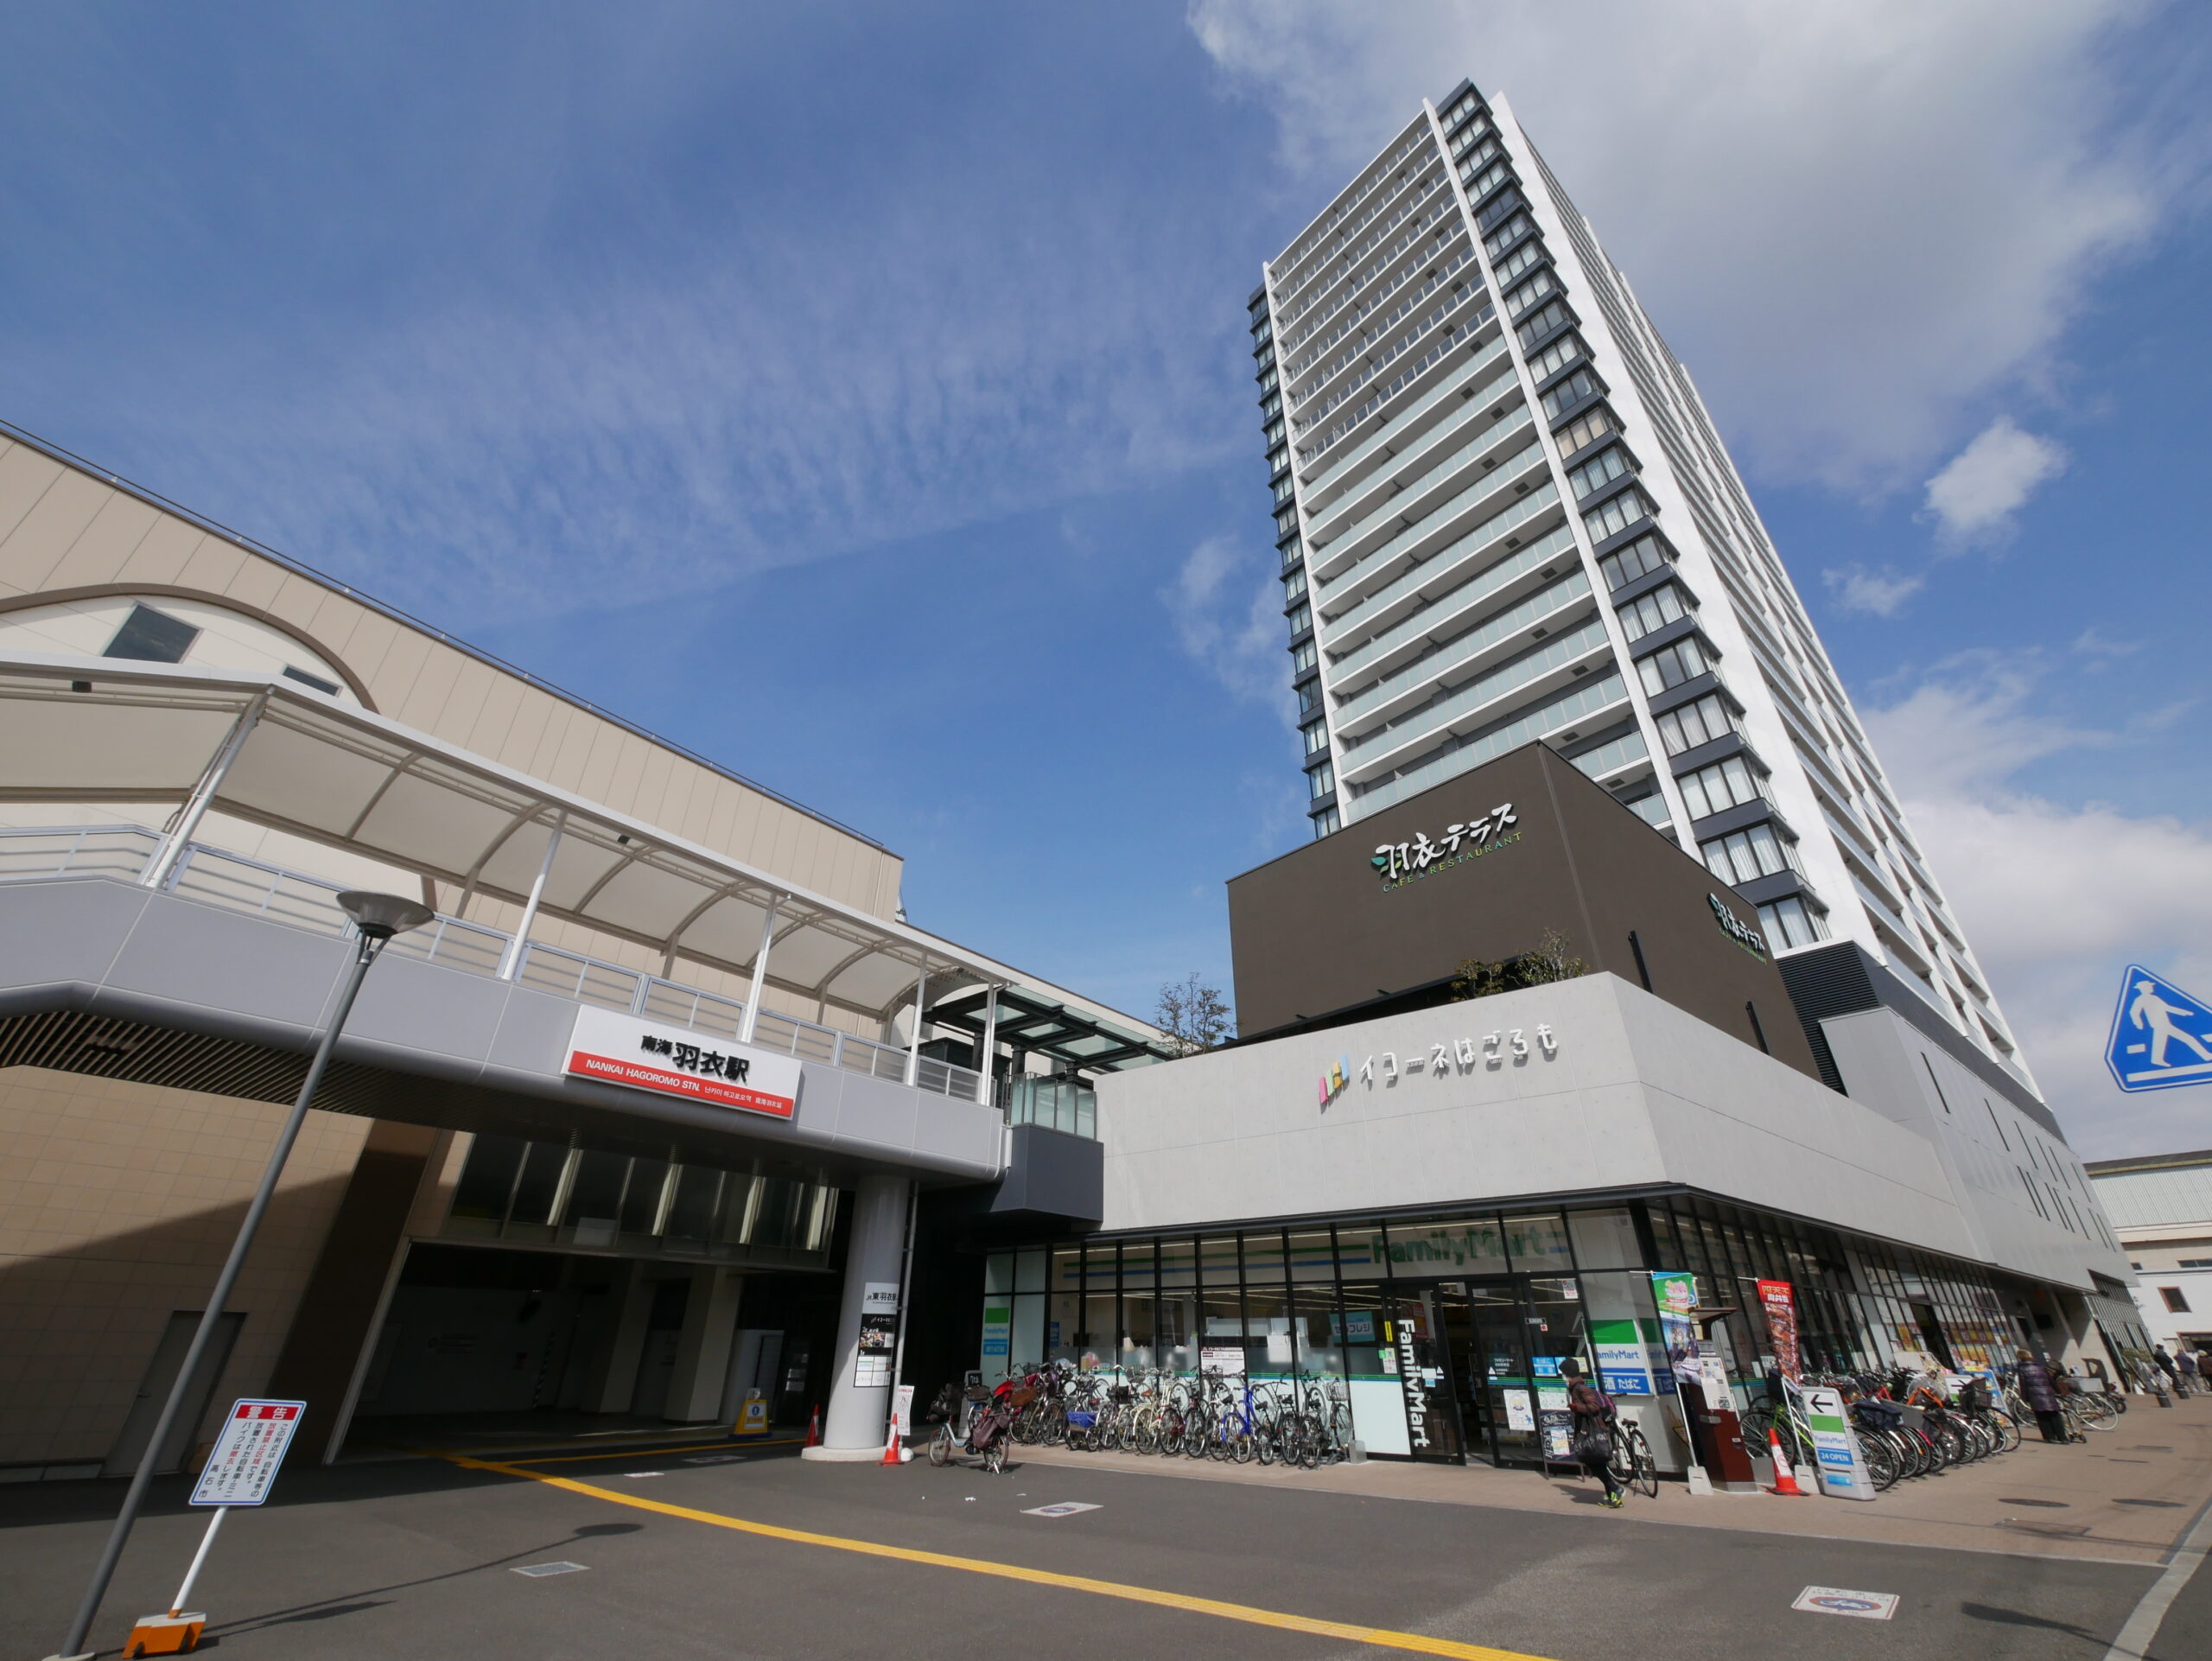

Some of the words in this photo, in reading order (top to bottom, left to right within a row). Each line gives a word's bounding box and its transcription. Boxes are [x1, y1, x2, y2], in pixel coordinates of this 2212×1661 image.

[1371, 803, 1517, 879] 羽衣テラス
[1382, 874, 1414, 893] CAFE
[1429, 832, 1522, 875] RESTAURANT
[1360, 1023, 1557, 1080] イコーネはごろも
[586, 1059, 624, 1074] NANKAI
[626, 1068, 680, 1087] HAGOROMO
[682, 1080, 701, 1091] STN.
[1596, 1350, 1640, 1360] amilyMart
[246, 1405, 288, 1420] 警告
[1829, 1453, 1849, 1461] OPEN
